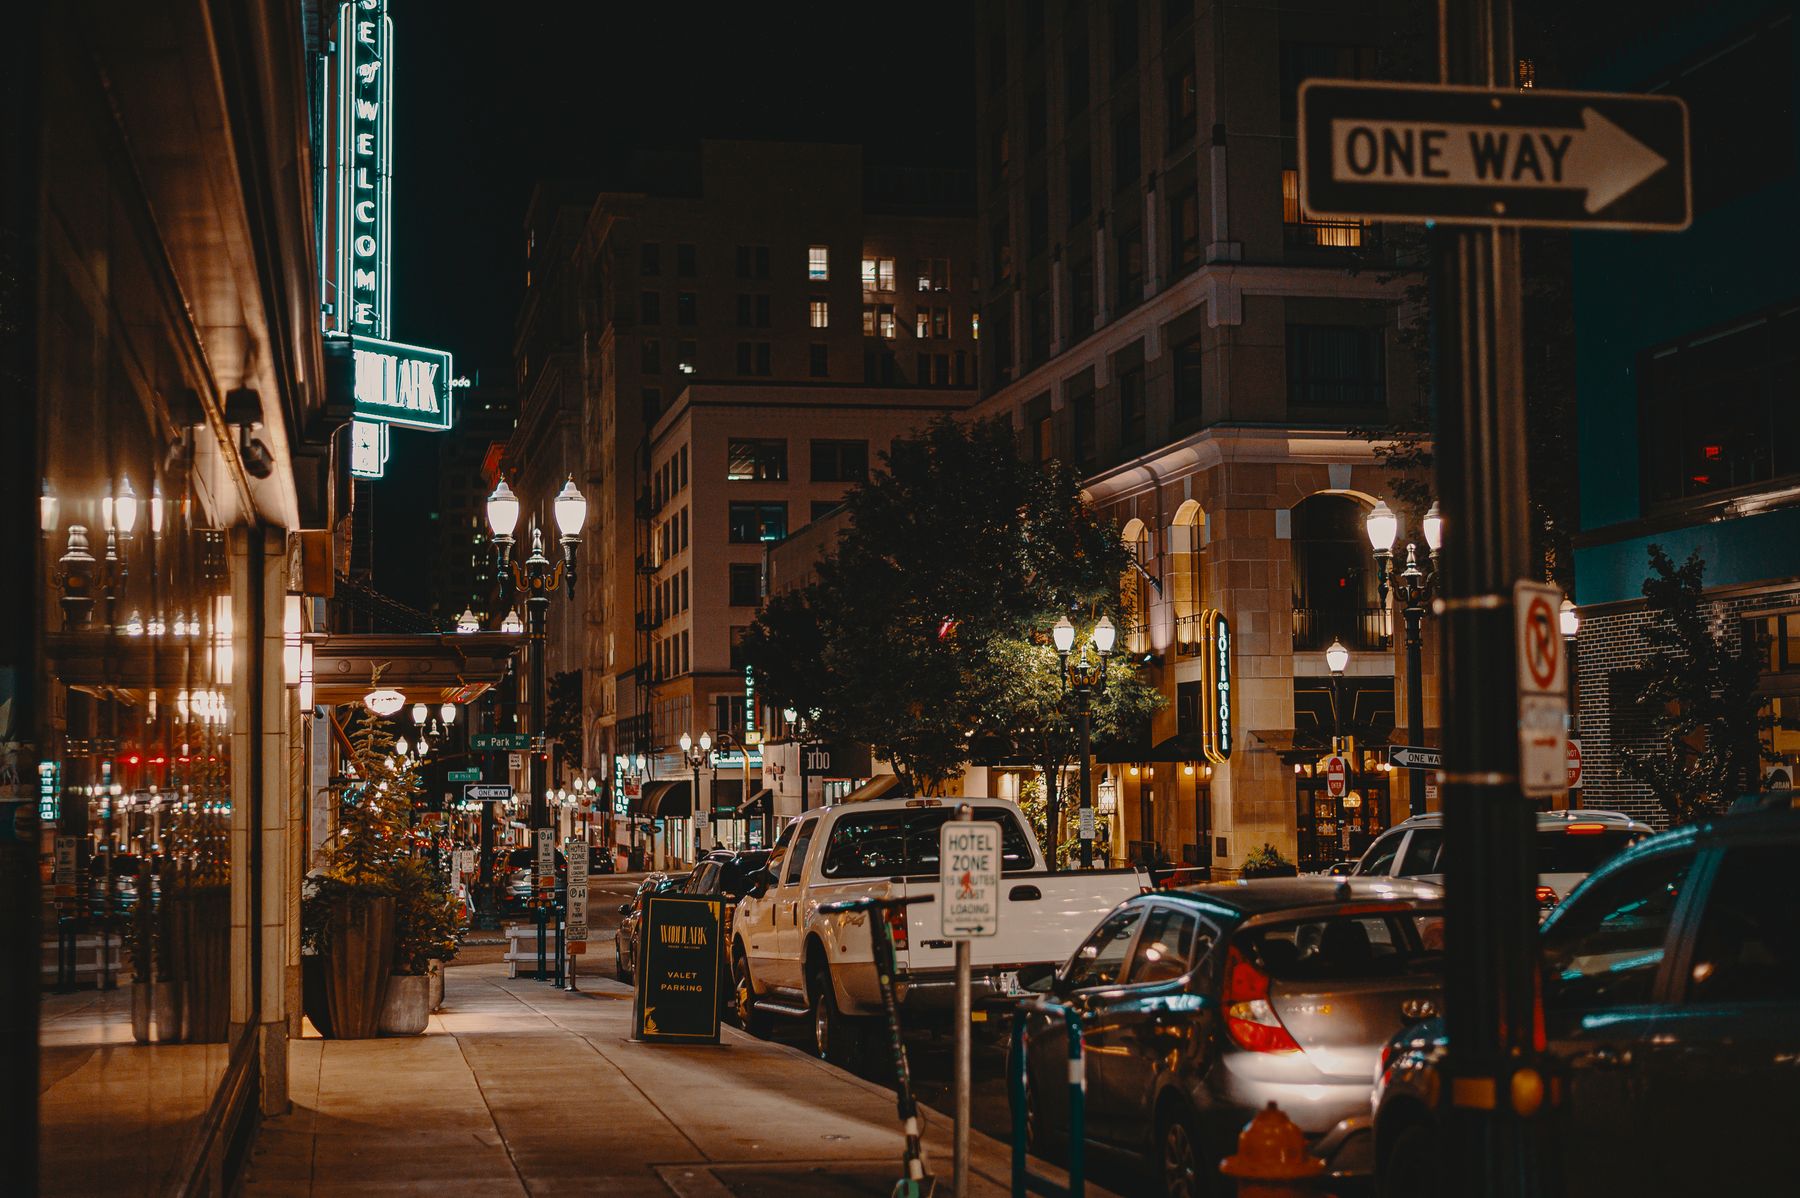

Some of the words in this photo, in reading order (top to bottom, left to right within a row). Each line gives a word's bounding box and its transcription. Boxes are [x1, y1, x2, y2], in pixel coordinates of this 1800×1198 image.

[1346, 126, 1450, 179] ONE
[1468, 131, 1573, 183] WAY
[354, 98, 379, 324] WELCOME
[1218, 622, 1227, 681] ROSA
[745, 665, 754, 731] COFFEE
[1219, 690, 1228, 750] ROSA
[491, 737, 510, 747] Park
[1408, 753, 1425, 763] ONE
[478, 789, 491, 797] ONE
[493, 789, 508, 797] WAY
[570, 845, 586, 853] HOTEL
[948, 834, 993, 851] HOTEL
[952, 855, 989, 871] ZONE
[950, 903, 989, 915] LOADING
[667, 971, 697, 980] VALET
[660, 983, 703, 992] PARKING
